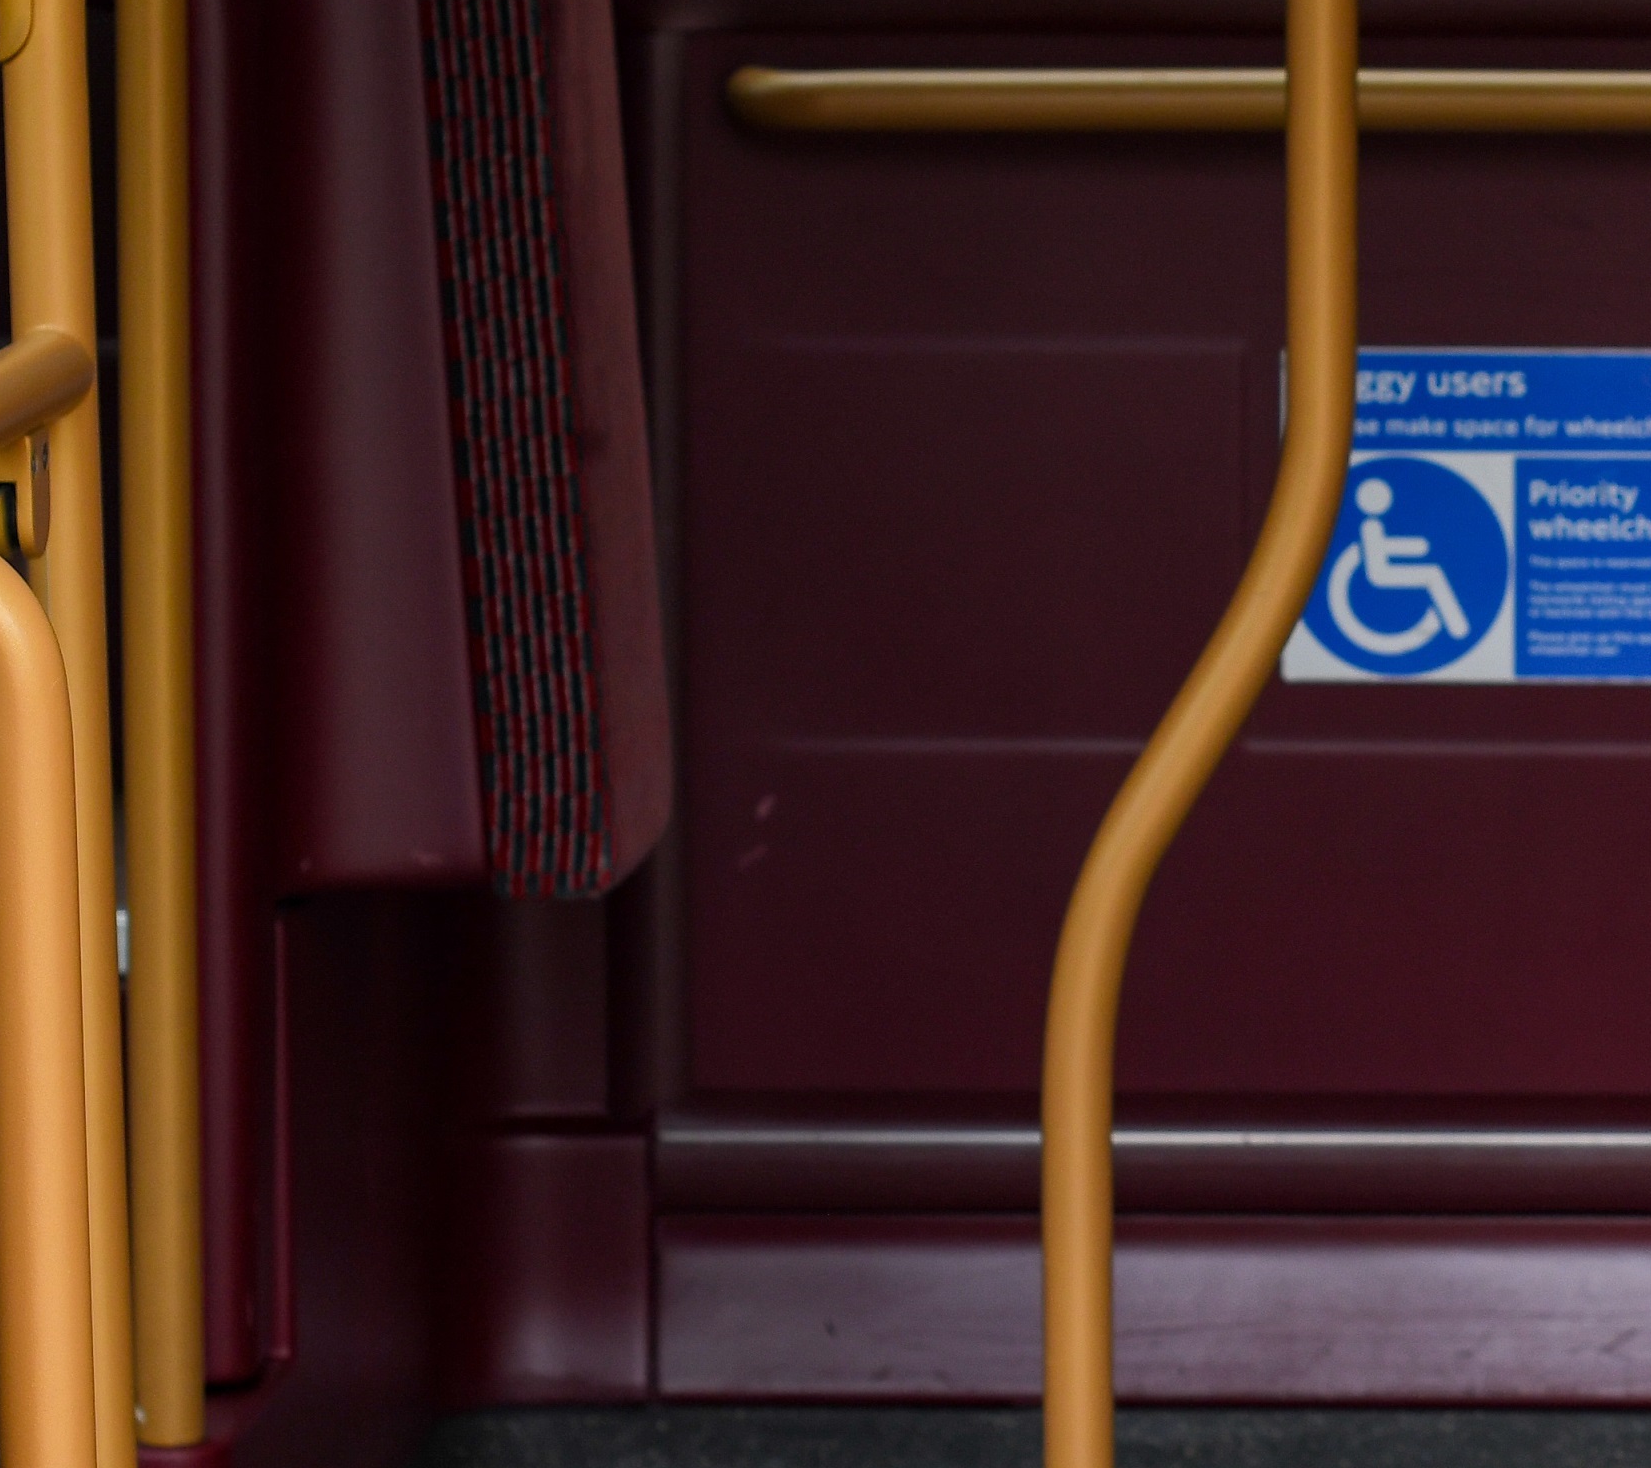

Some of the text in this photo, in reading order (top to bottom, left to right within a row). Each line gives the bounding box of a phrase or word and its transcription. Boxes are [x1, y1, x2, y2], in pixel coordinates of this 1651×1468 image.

[1355, 370, 1528, 404] ggy users
[1528, 478, 1640, 513] Priority
